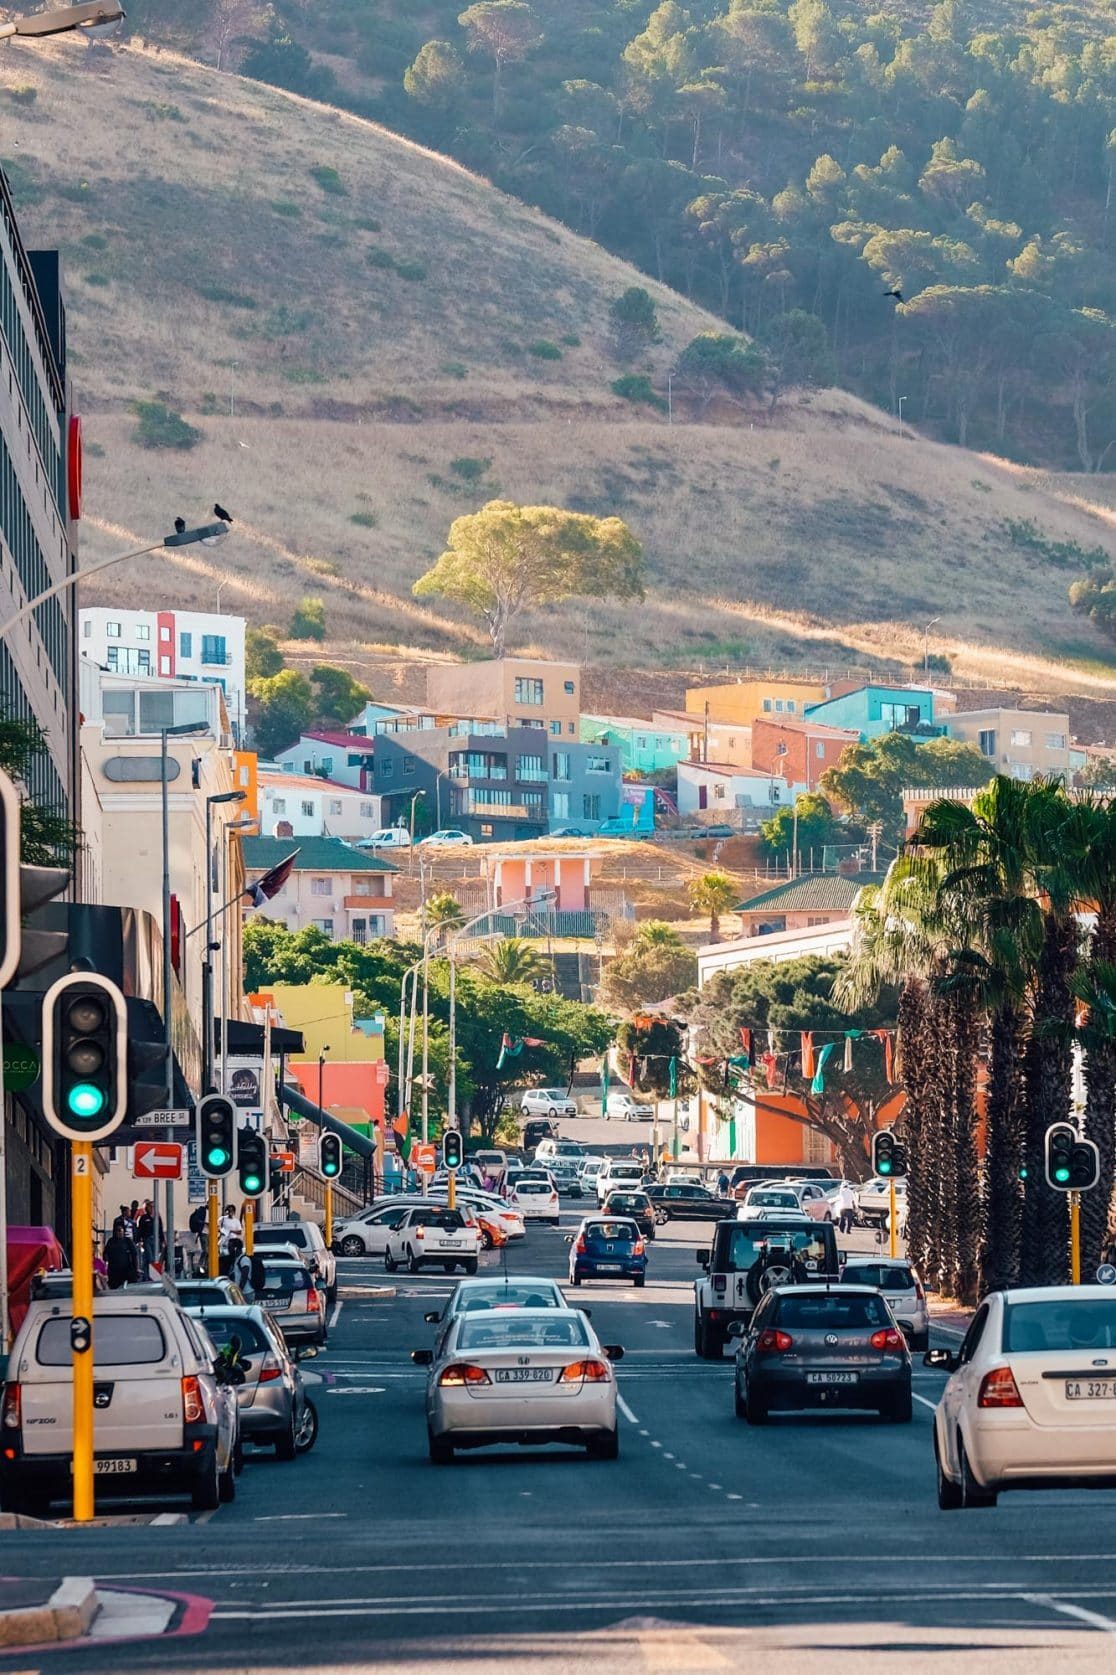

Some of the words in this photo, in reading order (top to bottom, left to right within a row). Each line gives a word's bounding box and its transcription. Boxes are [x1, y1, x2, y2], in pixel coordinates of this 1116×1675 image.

[154, 1112, 176, 1123] BREE
[77, 1158, 85, 1173] 2
[498, 1371, 510, 1380] CA
[812, 1373, 822, 1382] CA
[1066, 1383, 1081, 1397] CA
[97, 1460, 131, 1472] 99183
